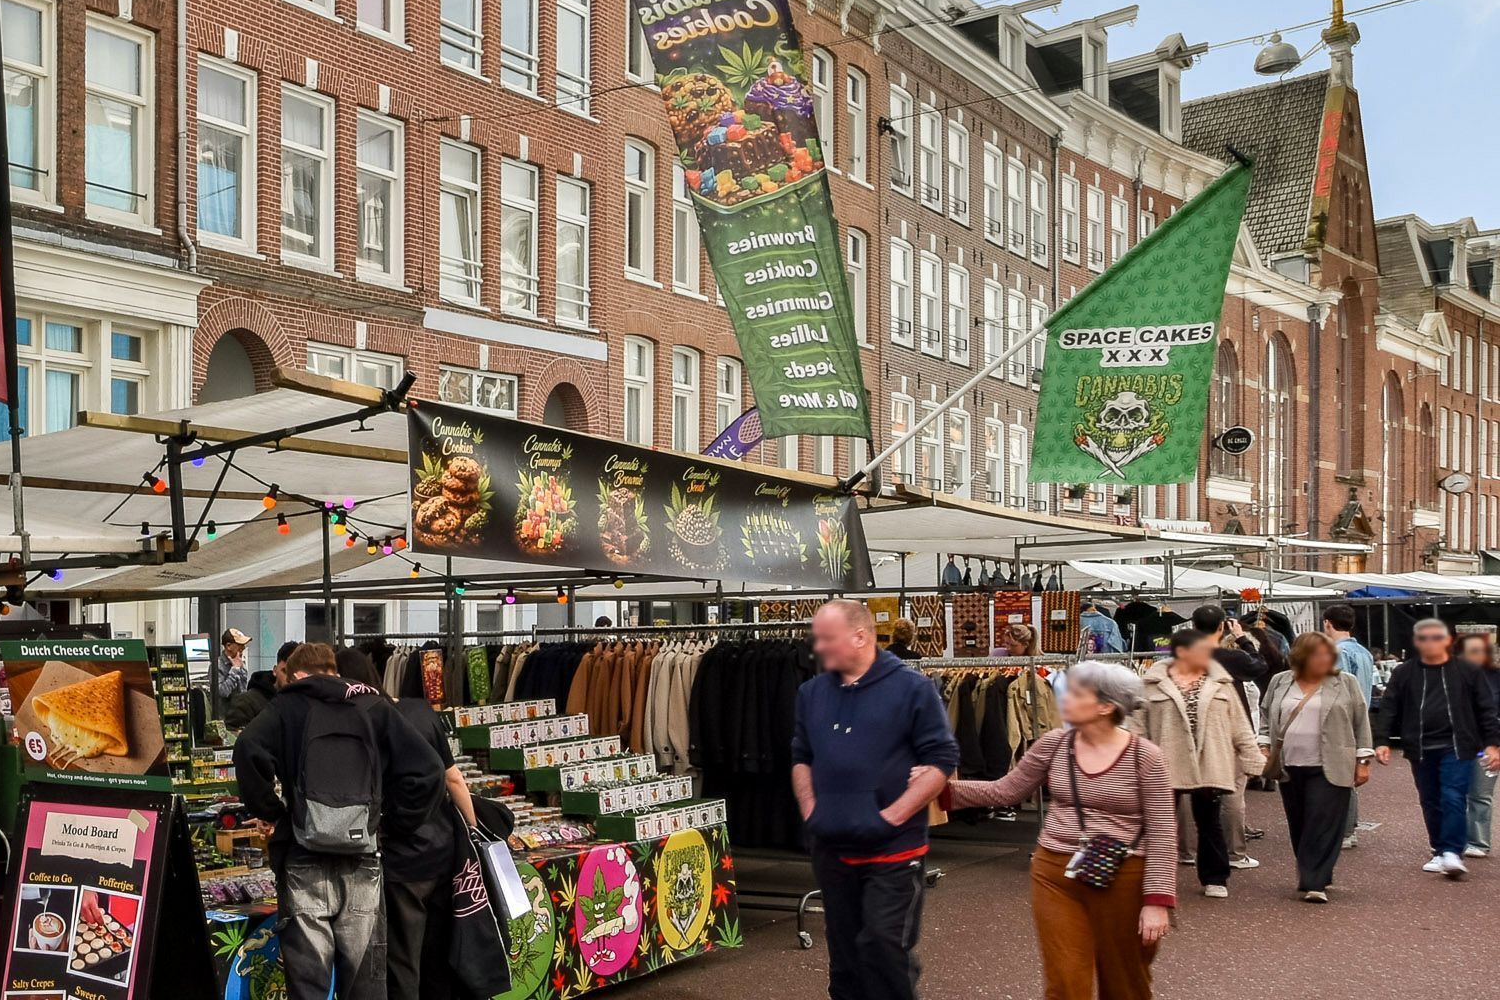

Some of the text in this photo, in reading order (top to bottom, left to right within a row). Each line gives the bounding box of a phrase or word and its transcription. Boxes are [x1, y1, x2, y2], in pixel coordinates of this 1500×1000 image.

[1061, 324, 1213, 347] SPACE CAKES
[1074, 374, 1184, 408] CANNABIS
[432, 416, 474, 439] Cannabis
[442, 437, 475, 456] Cookies
[523, 434, 563, 456] Cannabis
[604, 454, 640, 473] Cannabis
[20, 644, 125, 658] Dutch Cheese Crepe
[28, 738, 43, 754] €5
[62, 823, 119, 839] Mood Board
[29, 872, 73, 884] Coffee to Go
[98, 876, 134, 891] Poffertjes
[12, 978, 55, 989] Salty Crepes
